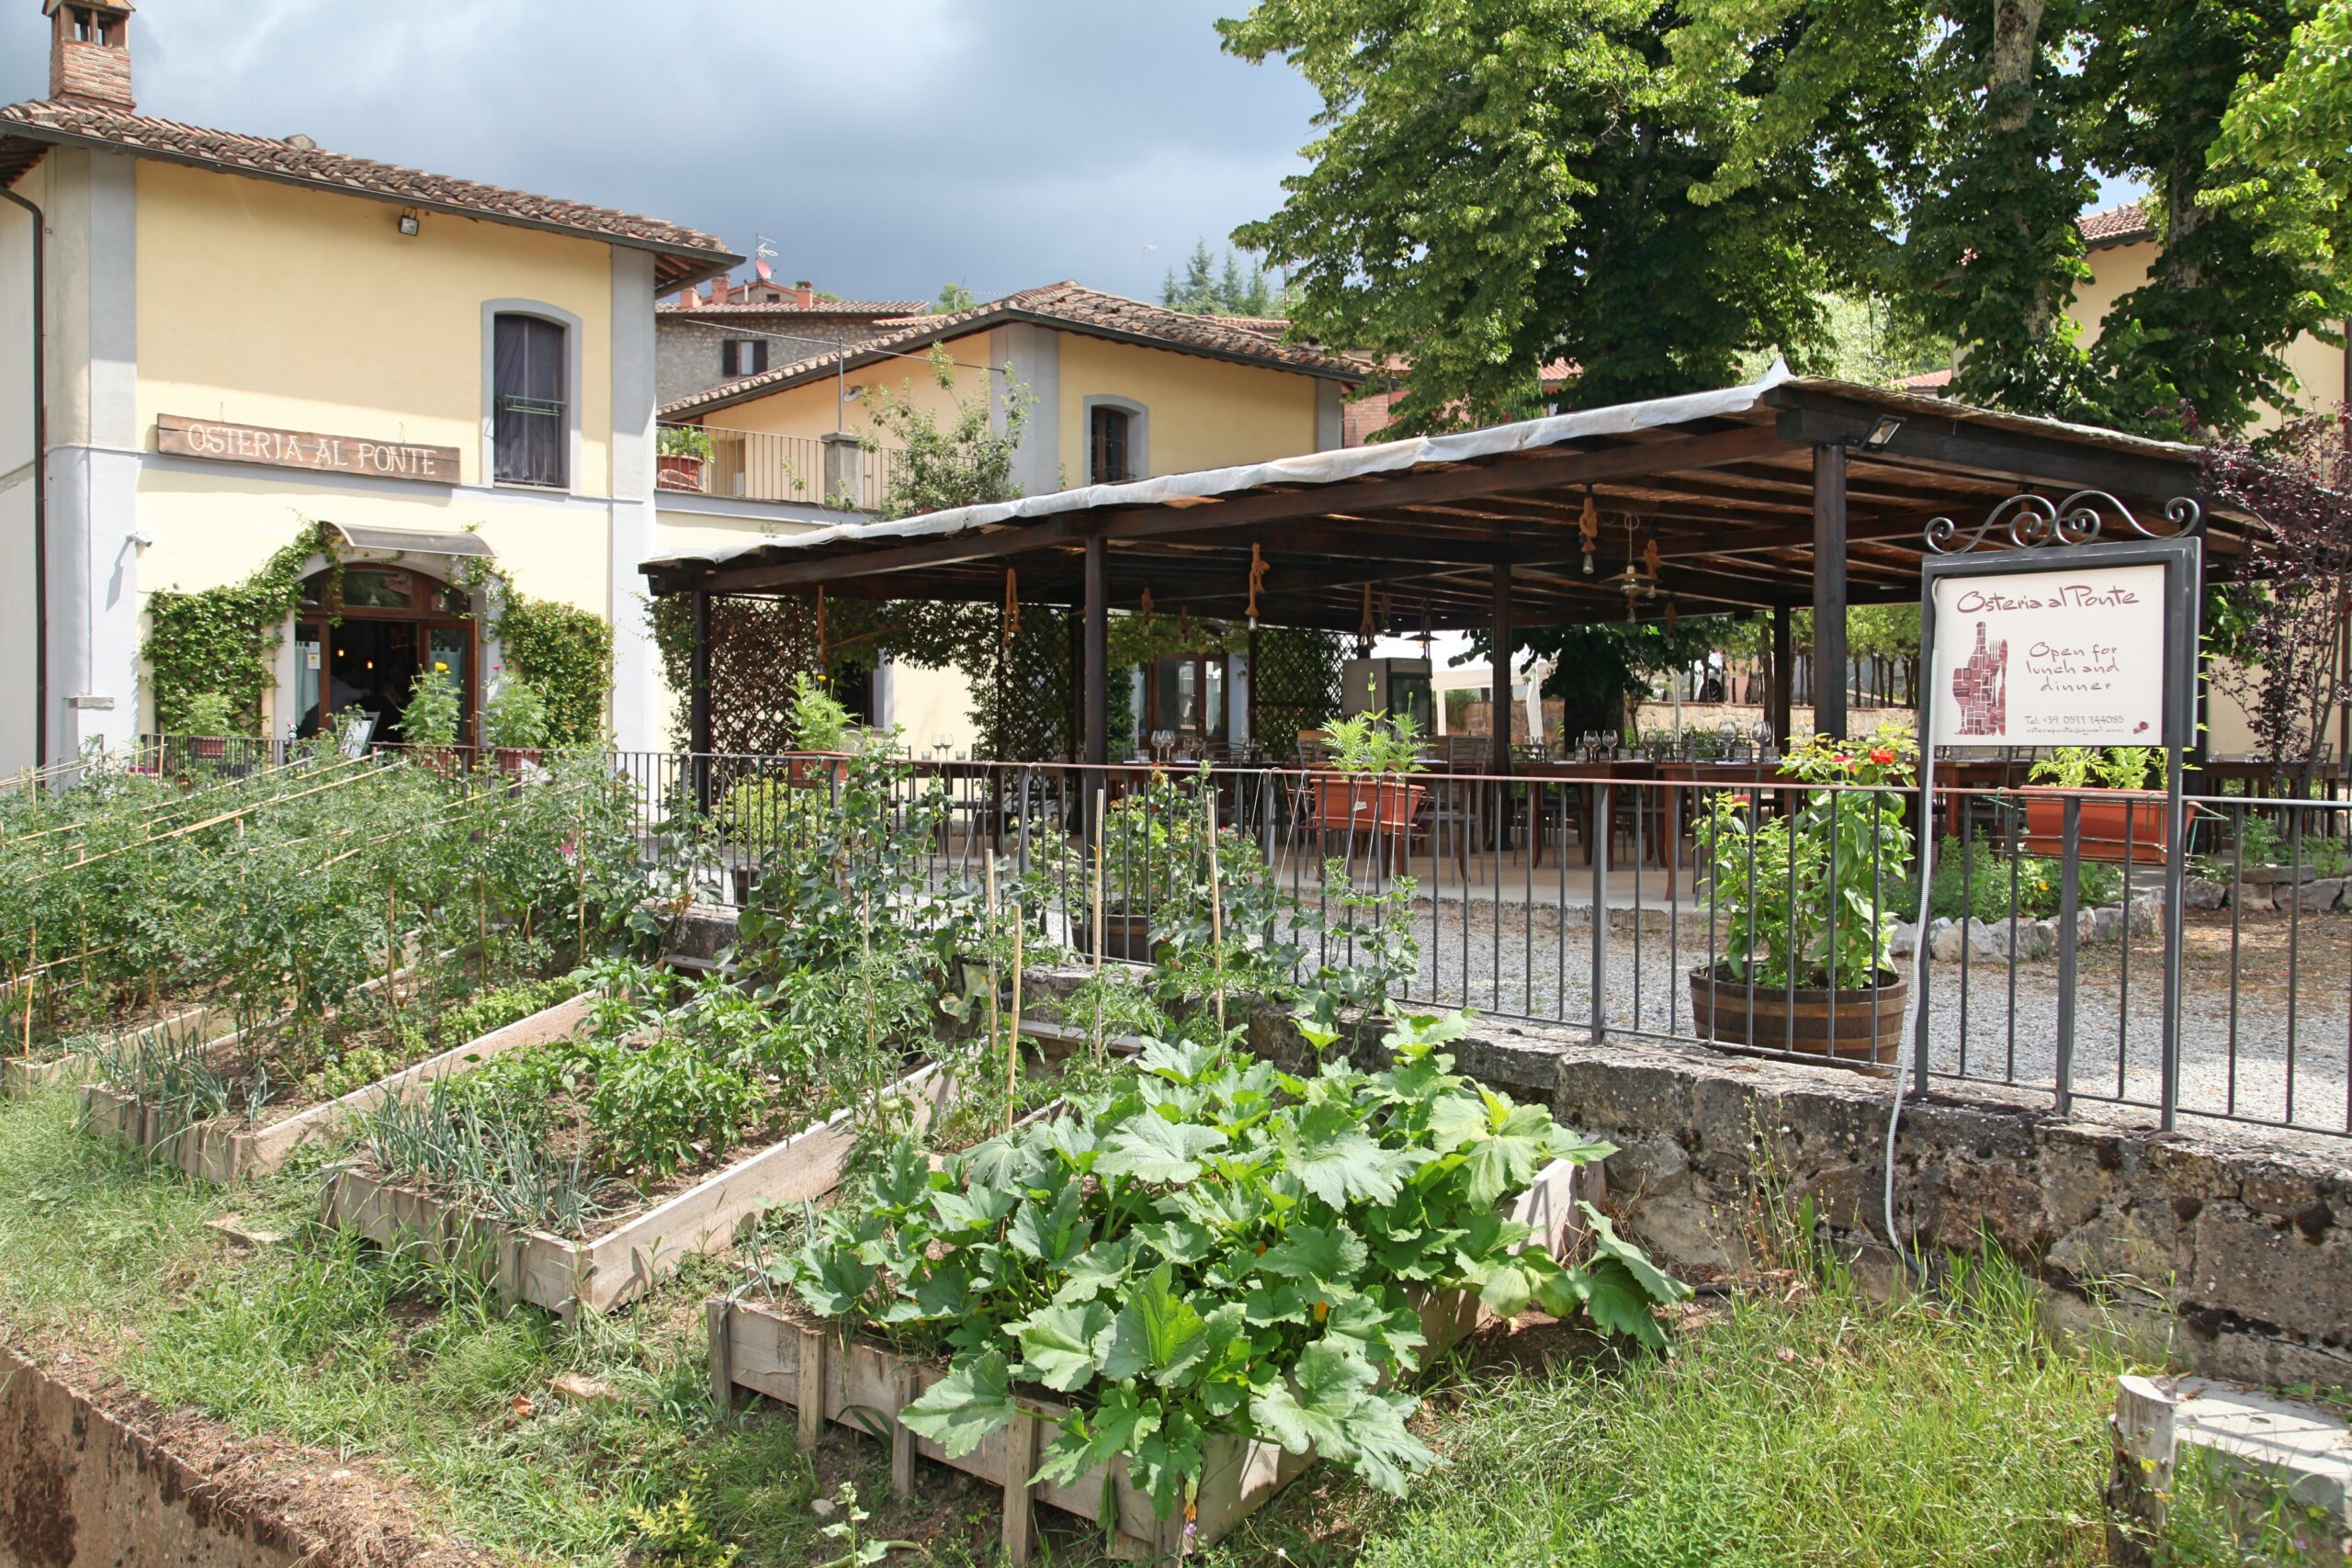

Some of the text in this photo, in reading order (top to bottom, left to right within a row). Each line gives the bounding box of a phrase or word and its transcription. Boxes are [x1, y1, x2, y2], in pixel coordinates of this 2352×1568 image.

[187, 423, 437, 476] OSTERIA AL PONTE
[1957, 584, 2140, 614] Osteria al Ponte
[2029, 641, 2118, 663] Open for
[2026, 656, 2120, 675] lunch and
[2040, 675, 2111, 692] dinner
[2042, 716, 2059, 725] +39
[2064, 716, 2086, 725] 0577
[2088, 715, 2124, 724] 744085
